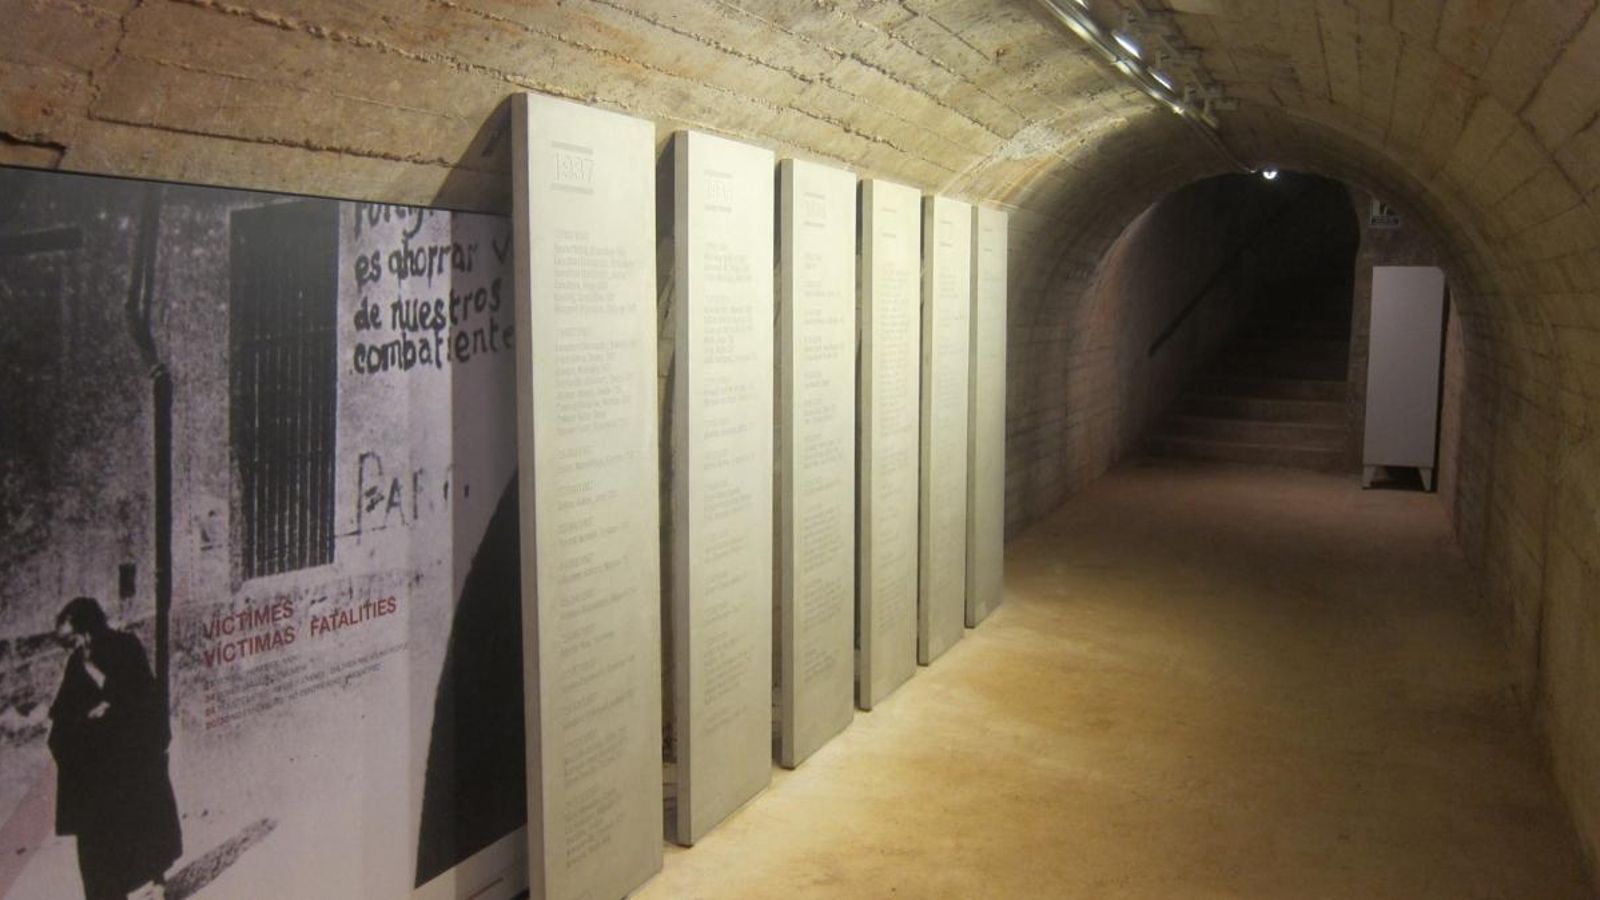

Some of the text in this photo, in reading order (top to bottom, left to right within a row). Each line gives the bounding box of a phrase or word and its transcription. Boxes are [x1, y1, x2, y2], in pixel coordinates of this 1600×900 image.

[355, 250, 381, 288] es
[388, 239, 477, 284] ahorrar
[354, 278, 502, 332] de nuestros
[310, 596, 397, 636] FATALITIES
